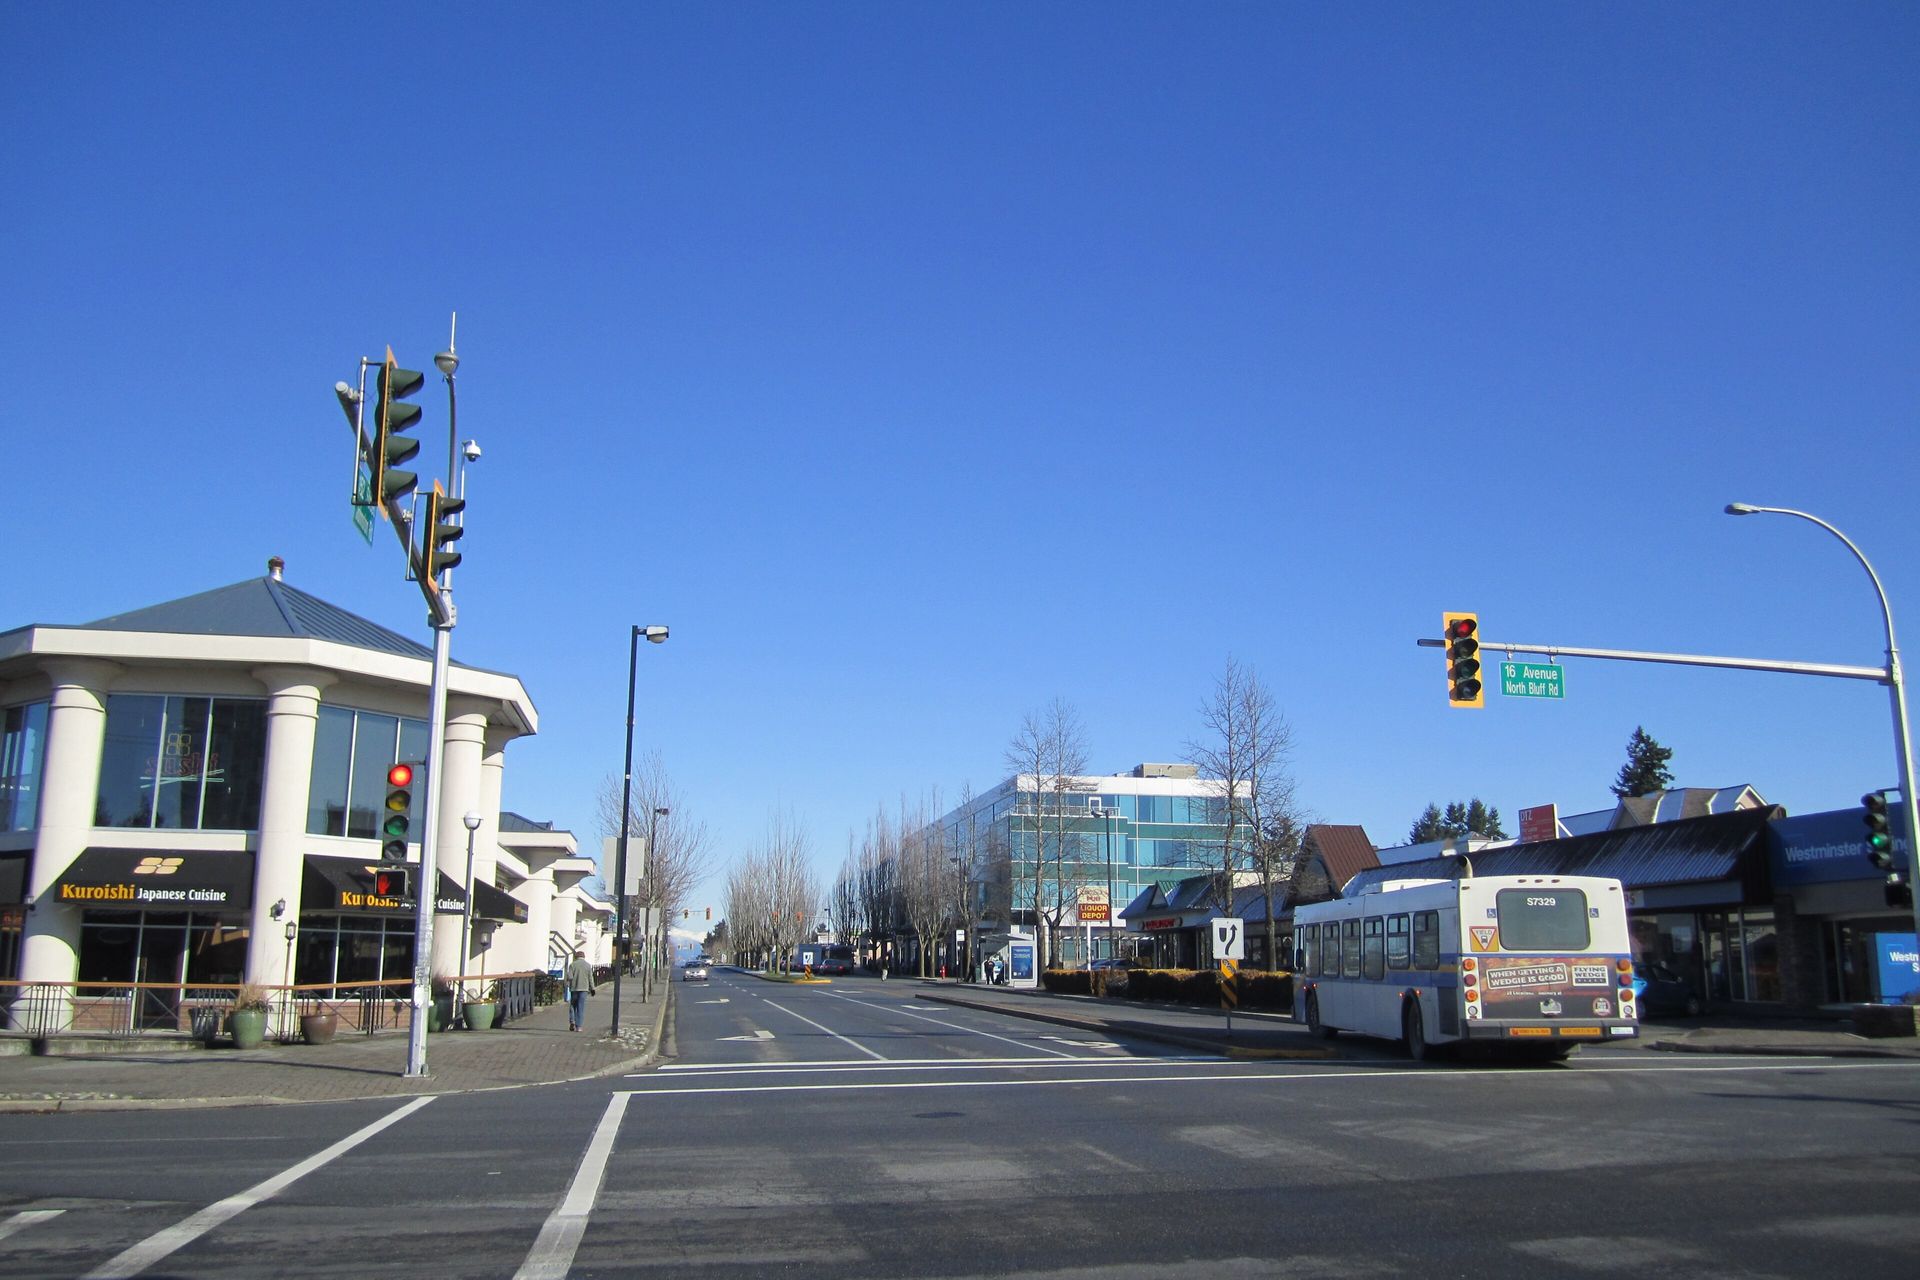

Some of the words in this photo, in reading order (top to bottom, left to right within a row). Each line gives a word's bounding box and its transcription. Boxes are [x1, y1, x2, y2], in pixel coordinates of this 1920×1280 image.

[1505, 664, 1516, 678] 16
[1523, 665, 1558, 680] Avenue
[1506, 681, 1526, 695] North
[1528, 682, 1547, 696] Bluff
[1549, 683, 1559, 696] Rd
[1785, 842, 1863, 862] Westminster
[62, 884, 135, 900] Kuroishi
[137, 888, 186, 902] Japanese
[188, 889, 227, 901] Cuisine
[438, 898, 466, 911] Cuisine
[1080, 904, 1108, 912] LIQUOR
[1527, 897, 1556, 906] S7329
[1490, 970, 1517, 978] WHEN
[1518, 966, 1555, 976] GETTING
[1491, 976, 1527, 986] WEDGIE
[1528, 975, 1537, 983] IS
[1538, 973, 1565, 982] GOOD
